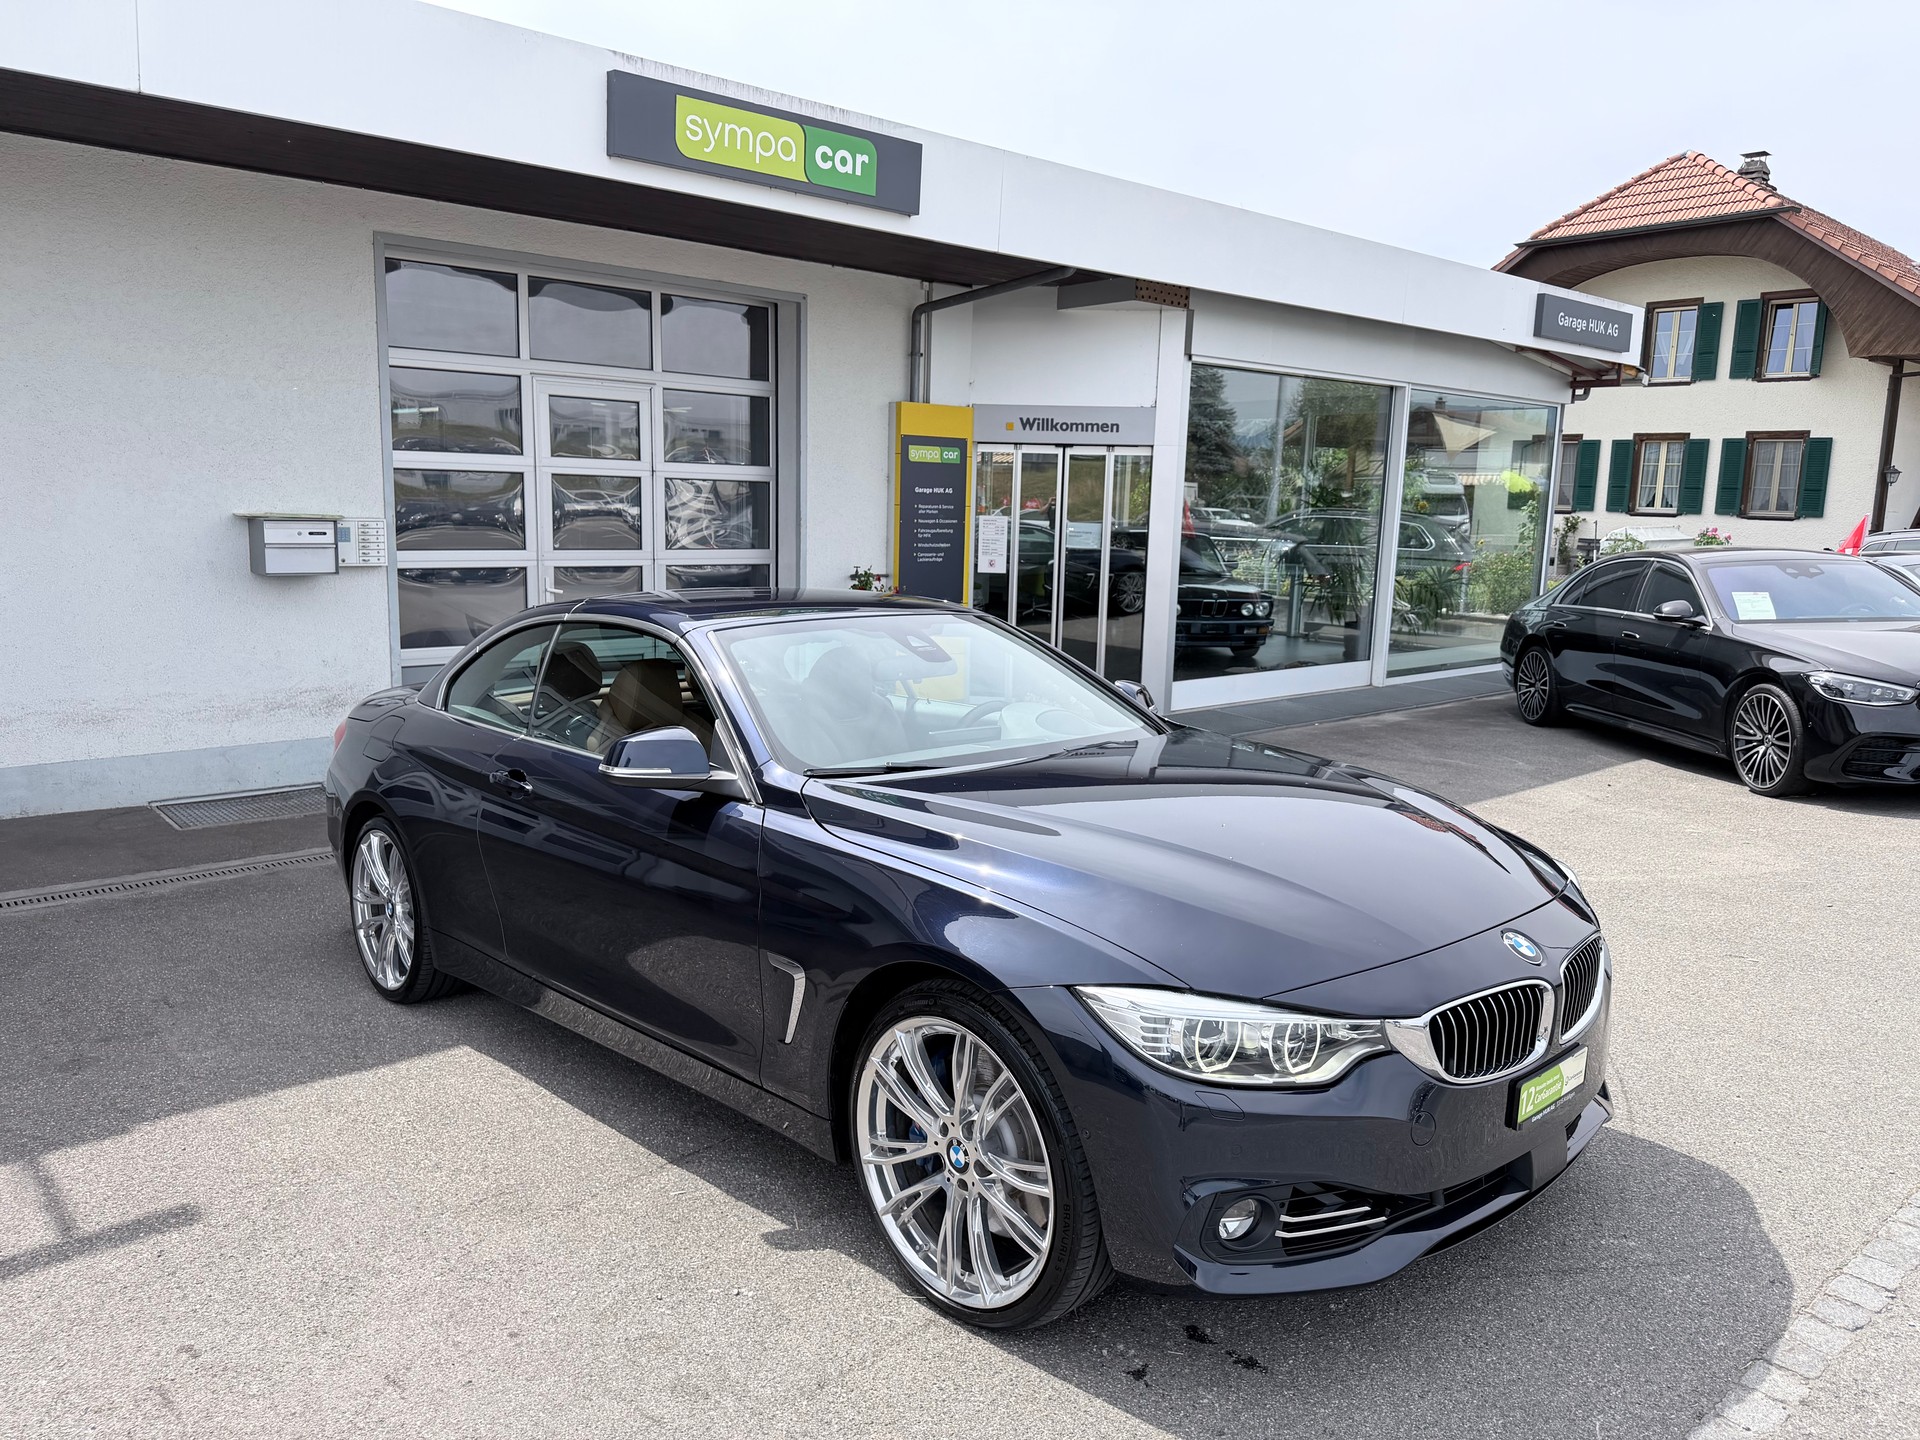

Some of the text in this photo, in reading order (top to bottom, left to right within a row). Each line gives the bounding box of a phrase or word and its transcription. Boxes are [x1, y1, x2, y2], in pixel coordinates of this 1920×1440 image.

[685, 114, 869, 177] sympa car
[1558, 312, 1619, 337] Garage HUK AG
[1019, 417, 1120, 433] Willkommen
[910, 449, 958, 460] sympa car
[1521, 1086, 1536, 1116] 12
